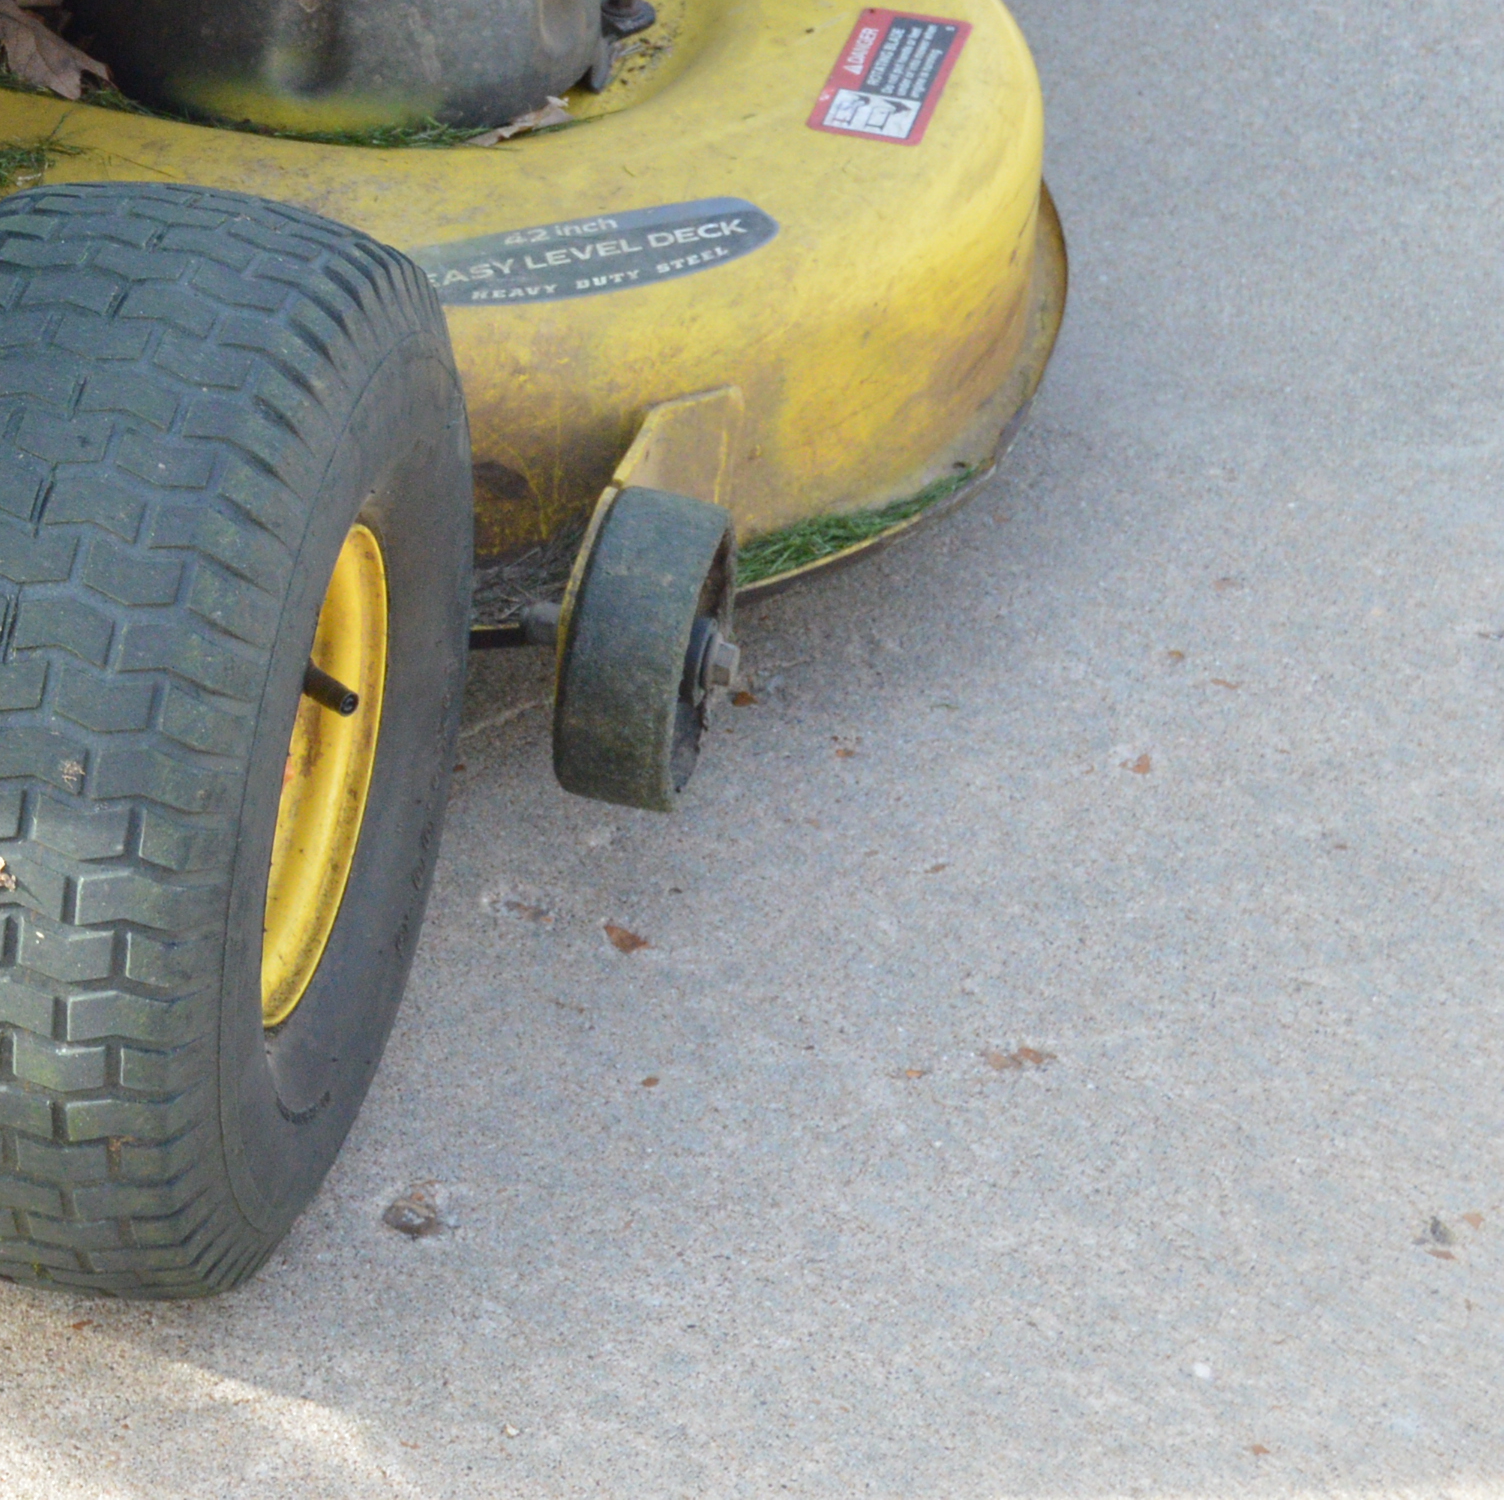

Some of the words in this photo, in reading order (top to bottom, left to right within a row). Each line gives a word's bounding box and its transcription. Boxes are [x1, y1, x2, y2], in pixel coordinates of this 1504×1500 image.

[847, 27, 879, 64] DANGER
[503, 228, 551, 246] 42
[554, 218, 619, 237] inch
[524, 238, 644, 270] LEVEL
[647, 218, 748, 248] DECK
[471, 283, 559, 300] HEAVY
[575, 269, 641, 290] DUTY
[655, 246, 730, 274] STEEL
